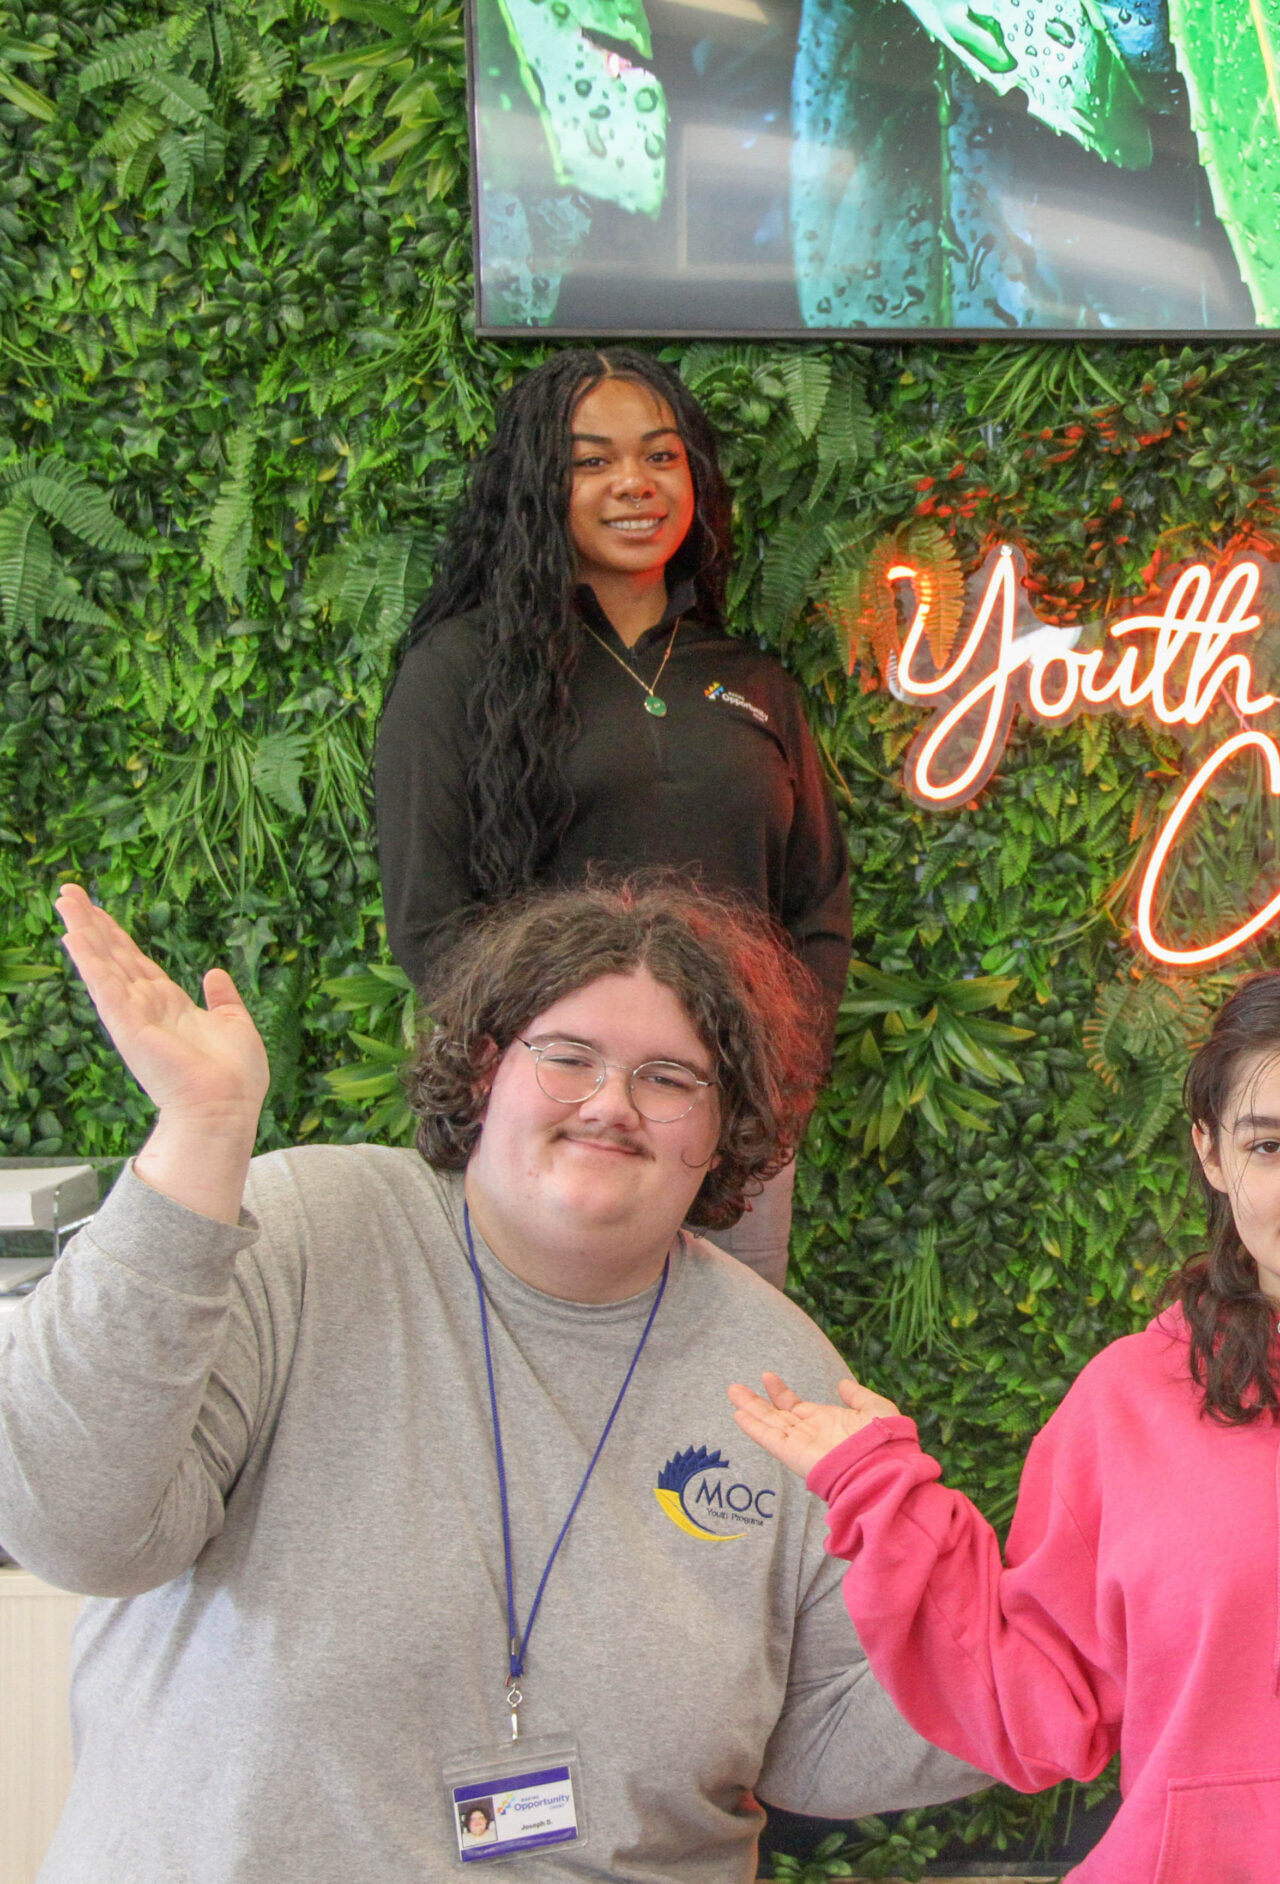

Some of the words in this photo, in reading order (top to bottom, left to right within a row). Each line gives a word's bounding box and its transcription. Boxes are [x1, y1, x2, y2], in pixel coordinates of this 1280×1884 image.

[886, 546, 1274, 801] Youth
[694, 1477, 776, 1519] MOC
[706, 1507, 728, 1520] Youth
[514, 1793, 570, 1812] Opportunity
